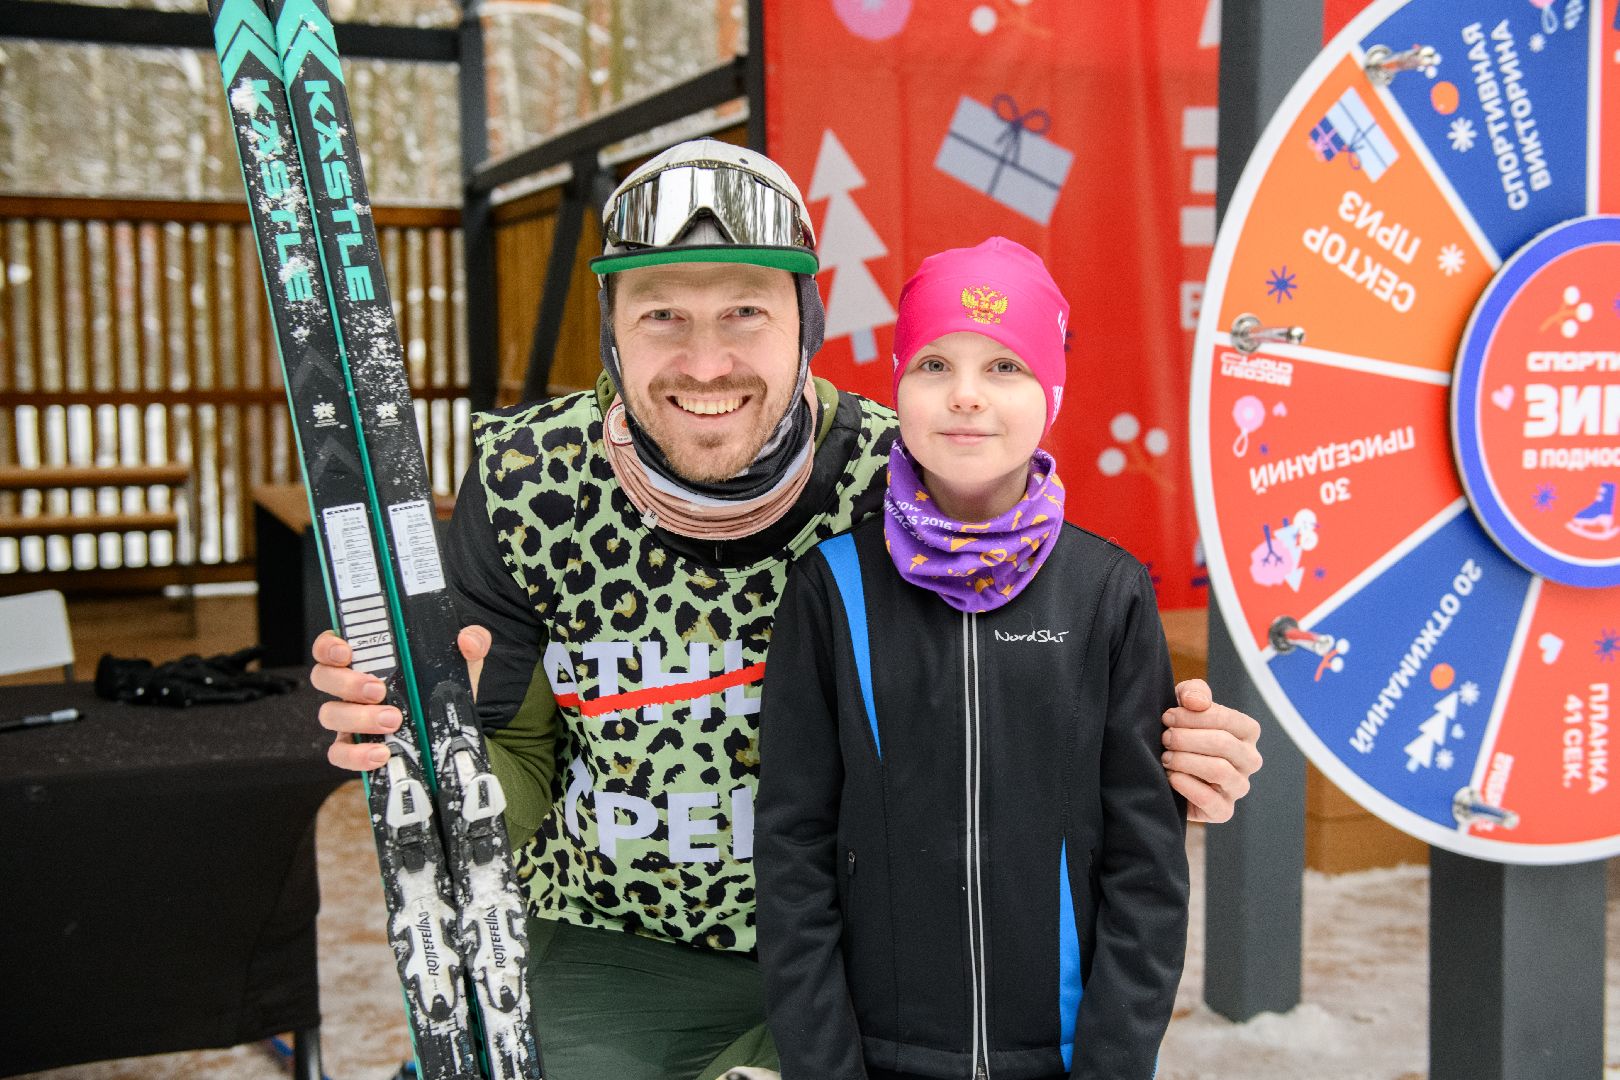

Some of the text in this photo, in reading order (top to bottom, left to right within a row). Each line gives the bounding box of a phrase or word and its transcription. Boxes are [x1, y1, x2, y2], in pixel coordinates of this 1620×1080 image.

[1461, 22, 1529, 210] СПОРТИВНАЯ
[1490, 18, 1552, 192] ВИКТОРИНА
[1337, 190, 1421, 264] ПРИЗ
[1302, 225, 1416, 313] СЕКТОР
[1249, 425, 1415, 495] ПРИСЕДАНИЙ
[1319, 477, 1351, 505] 30
[1522, 448, 1538, 470] В
[921, 516, 952, 530] 2016
[994, 629, 1070, 643] NordSki
[1349, 558, 1482, 753] 20 ОТЖИМАНИЙ
[1563, 694, 1584, 788] 41 СЕК.
[1588, 683, 1610, 794] ПЛАНКА
